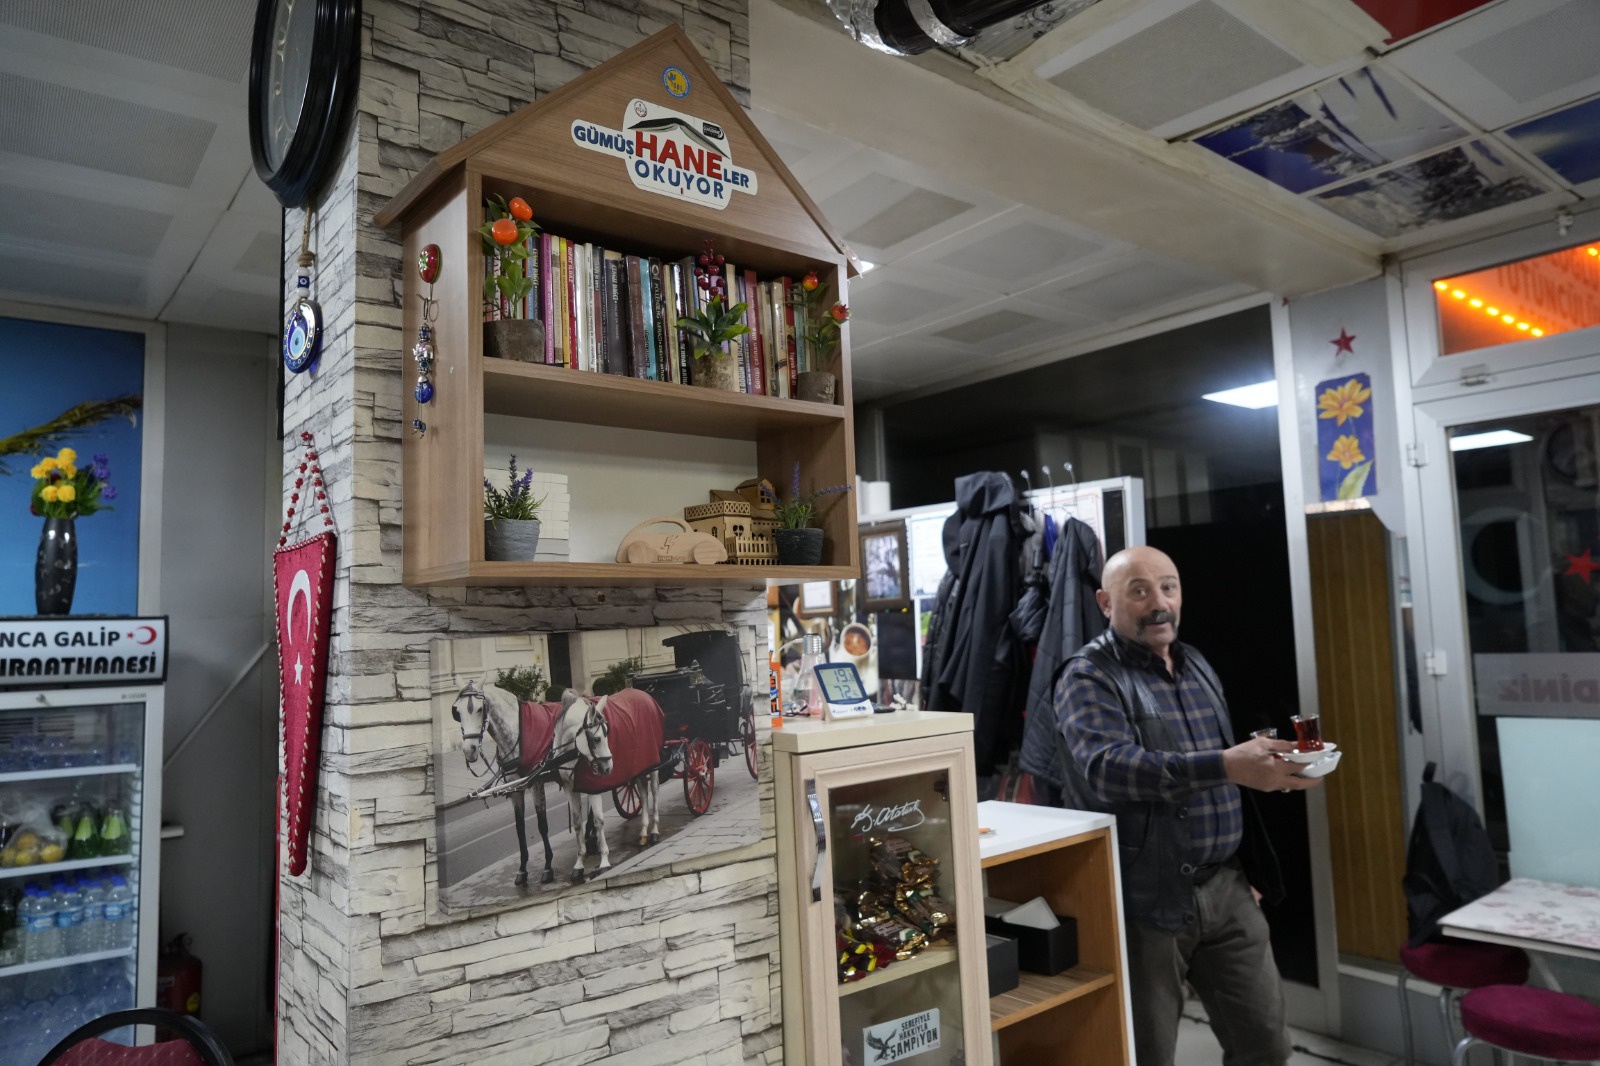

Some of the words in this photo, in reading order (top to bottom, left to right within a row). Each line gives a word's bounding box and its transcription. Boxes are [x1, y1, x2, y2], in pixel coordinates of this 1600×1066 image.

[635, 159, 724, 199] OKUYOR
[54, 626, 121, 647] GALİP
[890, 1027, 938, 1060] ŞAMPİYON
[898, 1022, 928, 1041] HAKKIYLA
